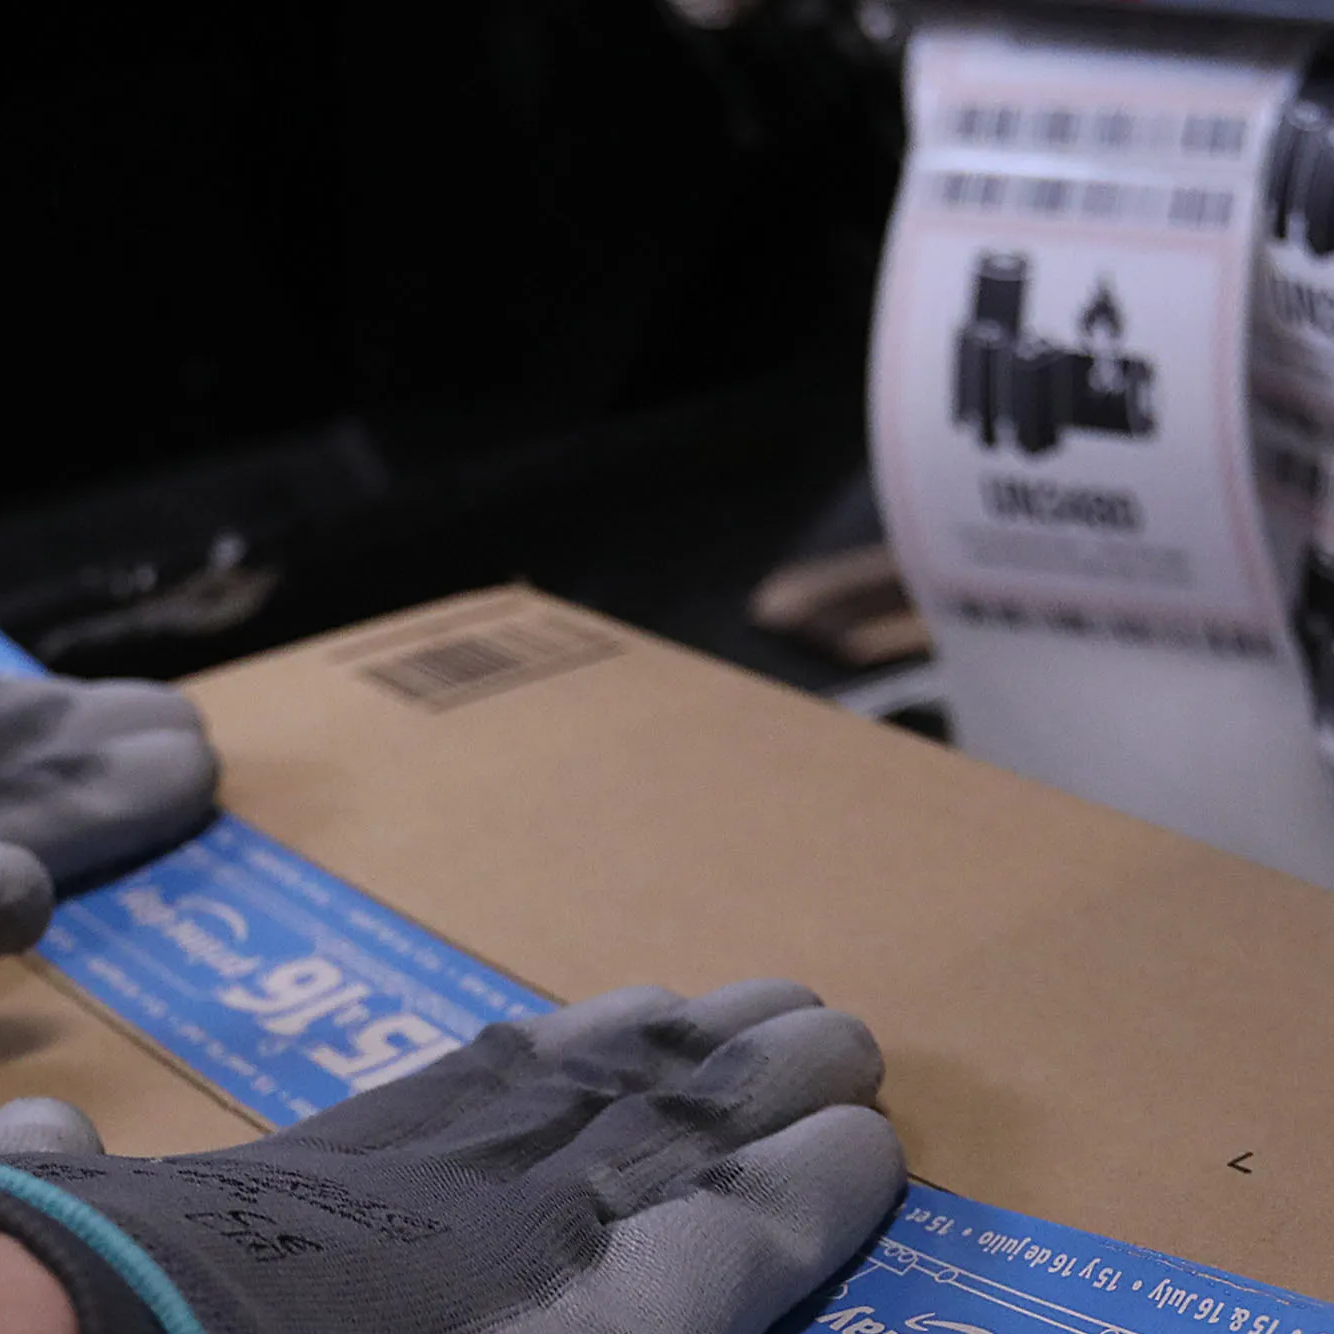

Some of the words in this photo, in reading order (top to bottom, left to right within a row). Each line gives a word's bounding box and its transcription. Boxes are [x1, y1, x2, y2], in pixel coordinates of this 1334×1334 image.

[218, 955, 371, 1036] 16
[307, 1012, 464, 1096] 15
[905, 1207, 932, 1224] et
[924, 1215, 955, 1236] 15
[978, 1230, 1032, 1261] julio
[1023, 1244, 1051, 1268] de
[1047, 1254, 1077, 1277] 16
[1078, 1257, 1102, 1279] y
[1093, 1267, 1123, 1292] 15
[1148, 1279, 1198, 1315] July
[1193, 1298, 1225, 1324] 16
[1229, 1306, 1251, 1332] &
